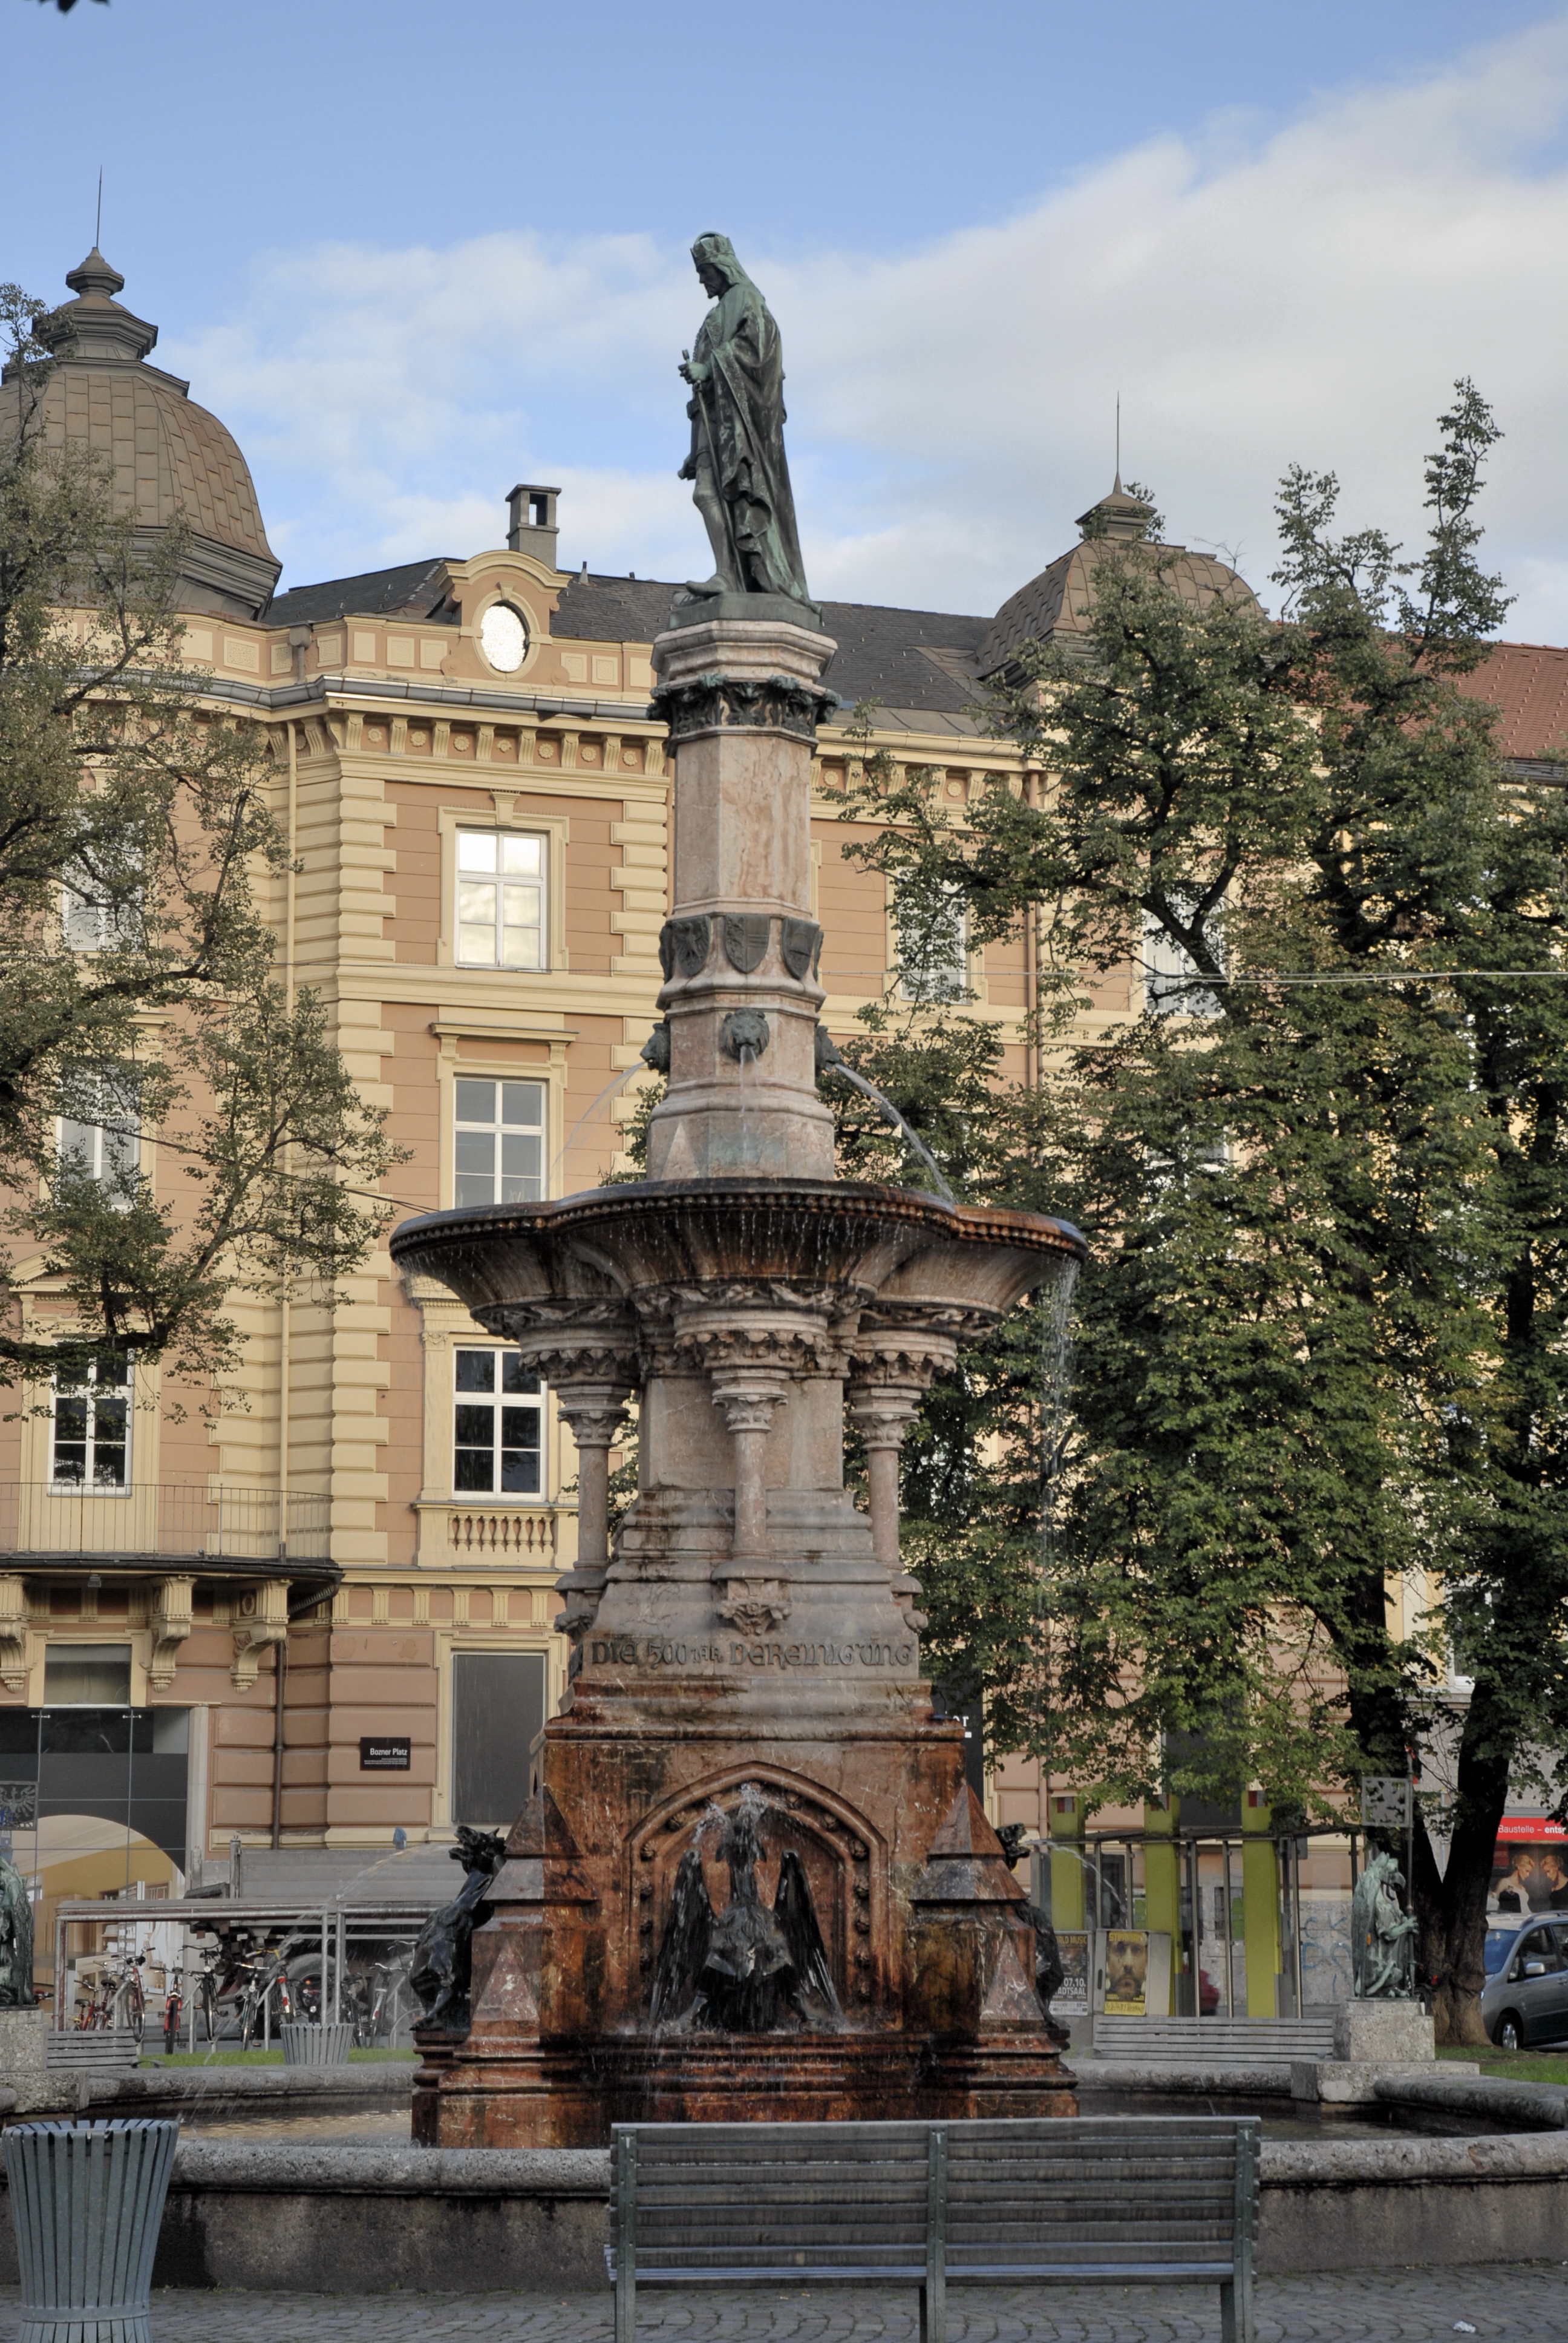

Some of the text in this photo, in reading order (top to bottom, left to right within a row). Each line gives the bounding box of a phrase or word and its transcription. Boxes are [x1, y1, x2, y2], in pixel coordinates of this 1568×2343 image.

[592, 1642, 638, 1665] DIE
[1498, 1824, 1534, 1833] Baustelle
[1063, 1977, 1086, 1987] 07.10.
[1054, 1987, 1086, 1996] ADTSAAL
